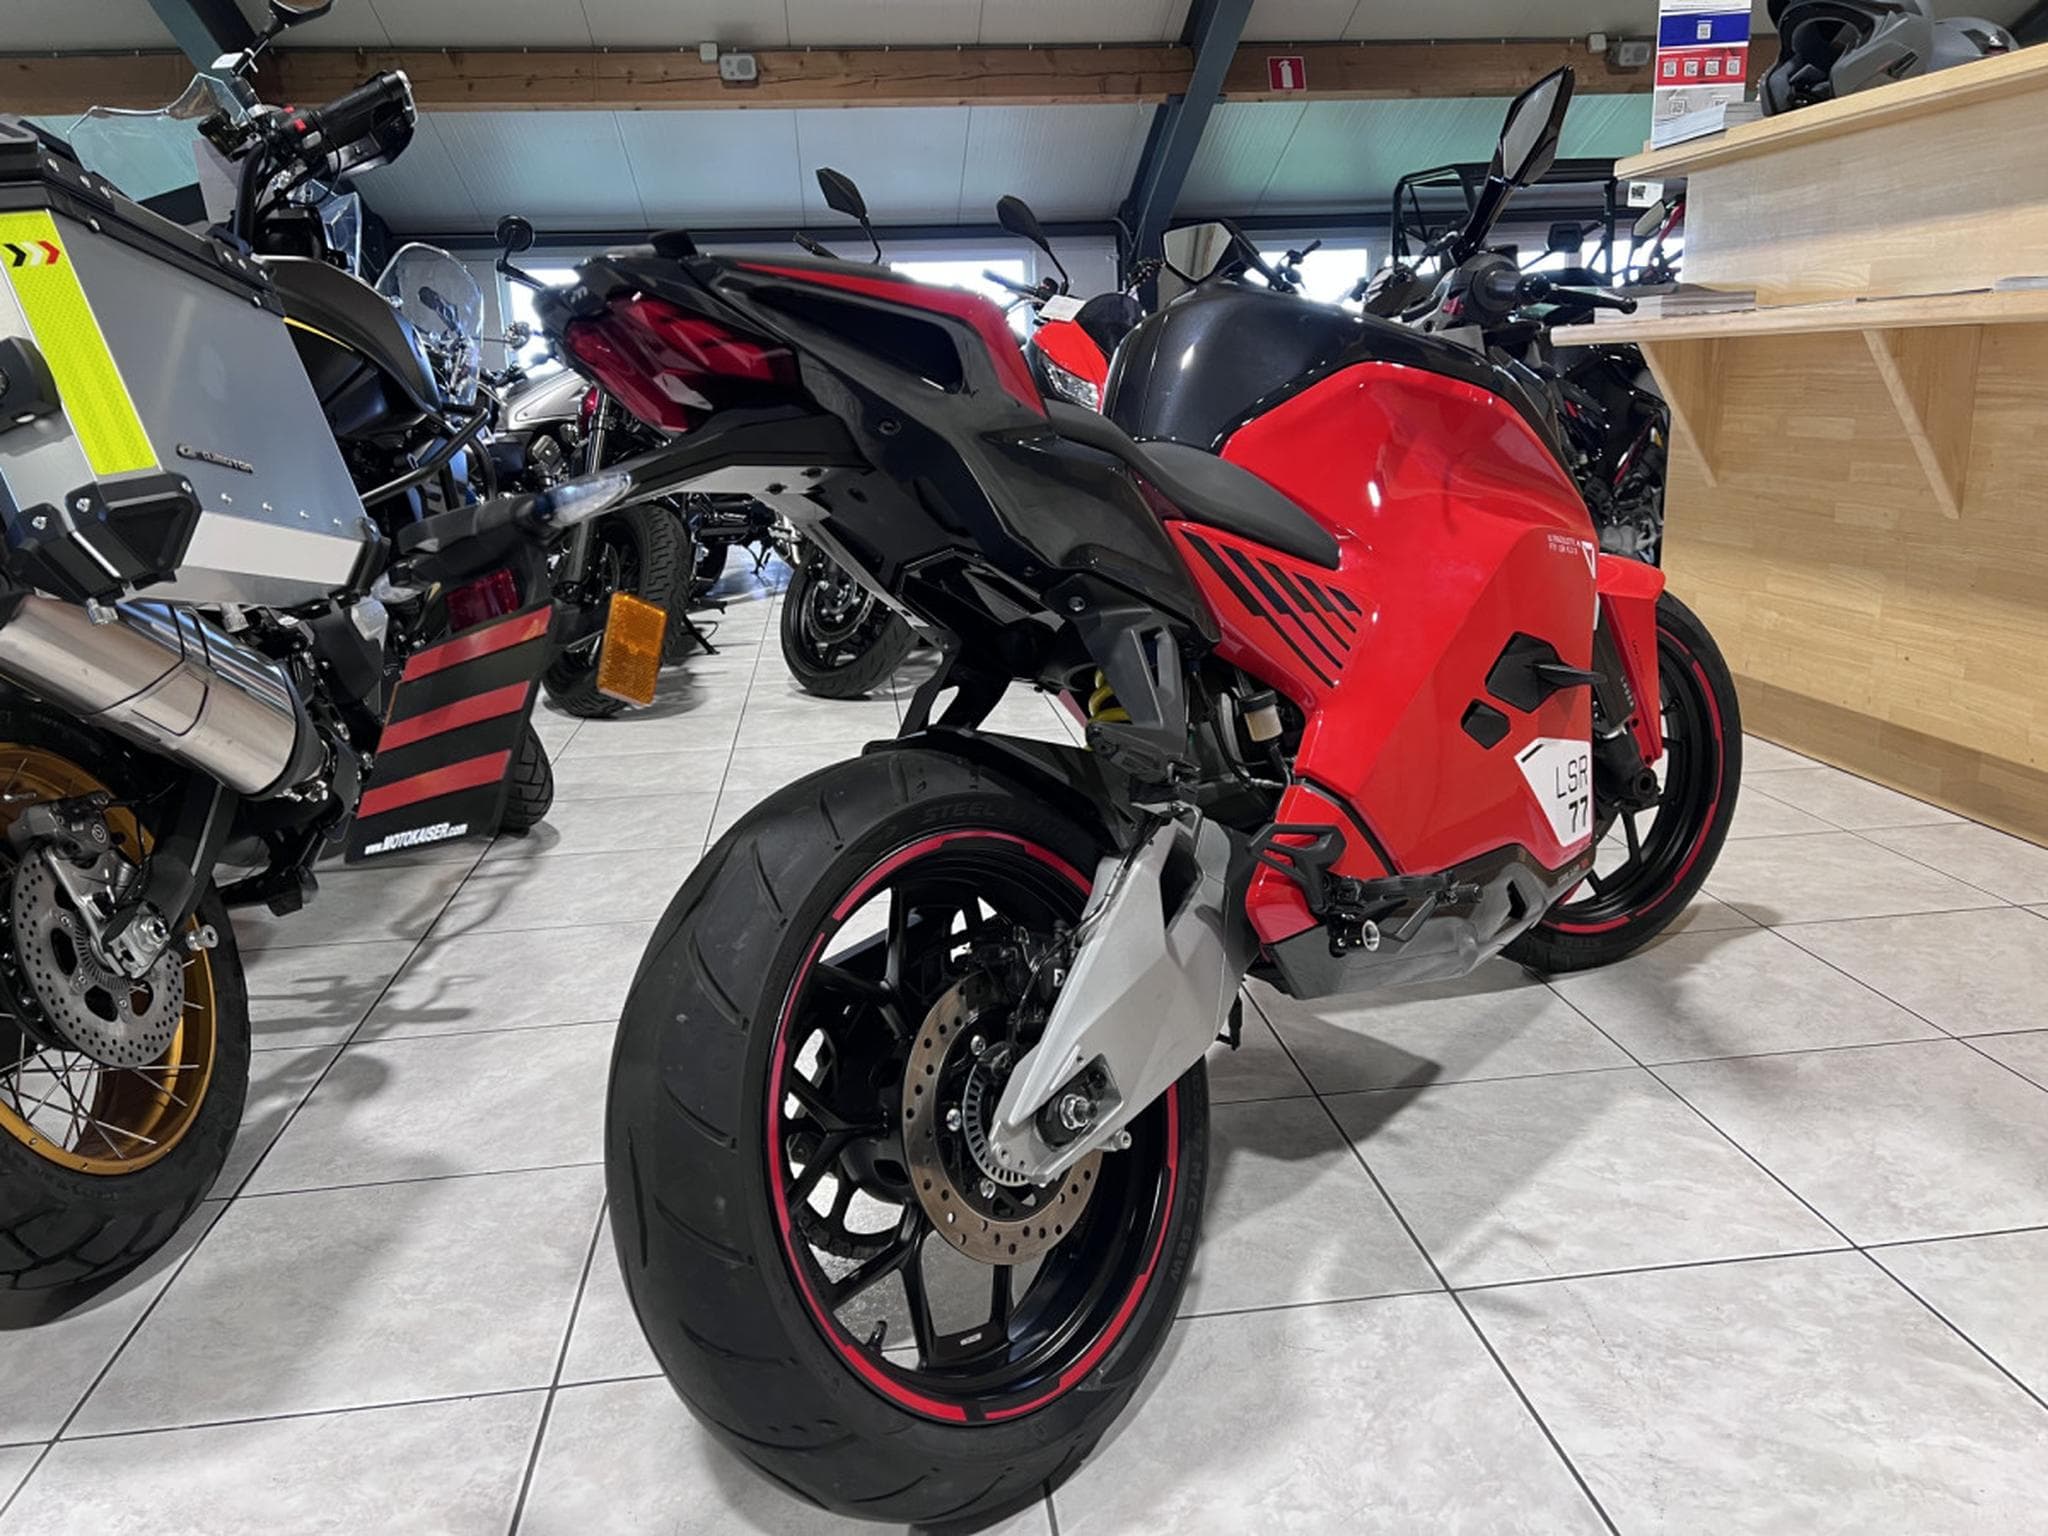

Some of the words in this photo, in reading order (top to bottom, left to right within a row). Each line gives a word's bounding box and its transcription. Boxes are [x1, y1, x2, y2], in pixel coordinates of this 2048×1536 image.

[1556, 754, 1588, 799] LSR
[920, 800, 999, 825] STEEL
[1568, 795, 1588, 833] 77
